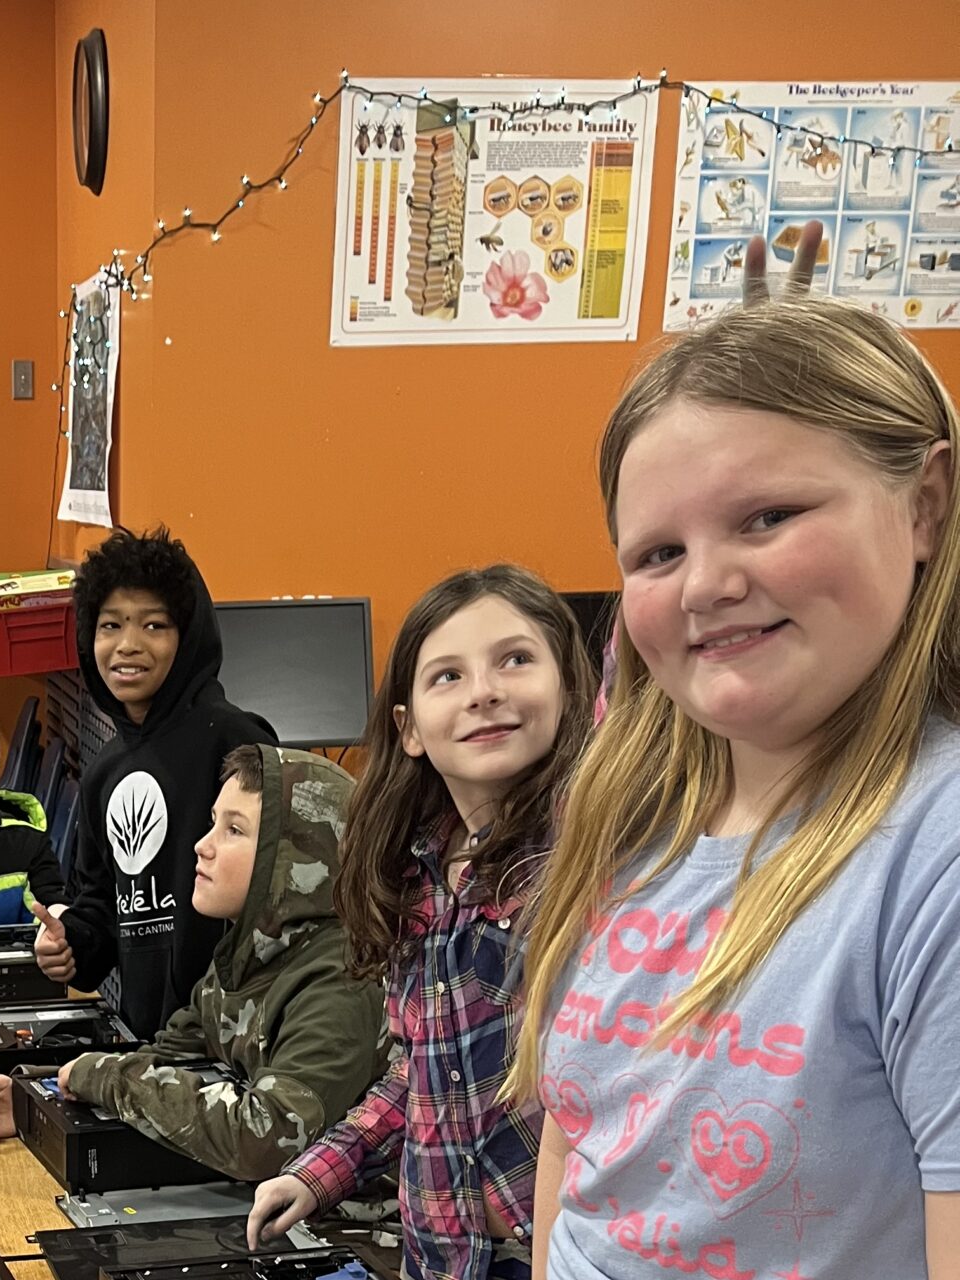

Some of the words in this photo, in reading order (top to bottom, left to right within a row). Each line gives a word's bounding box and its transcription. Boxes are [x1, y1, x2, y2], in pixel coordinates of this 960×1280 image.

[787, 83, 809, 95] The
[812, 83, 887, 97] Beekeeper's
[890, 83, 915, 95] Year
[137, 923, 174, 936] CANTINA
